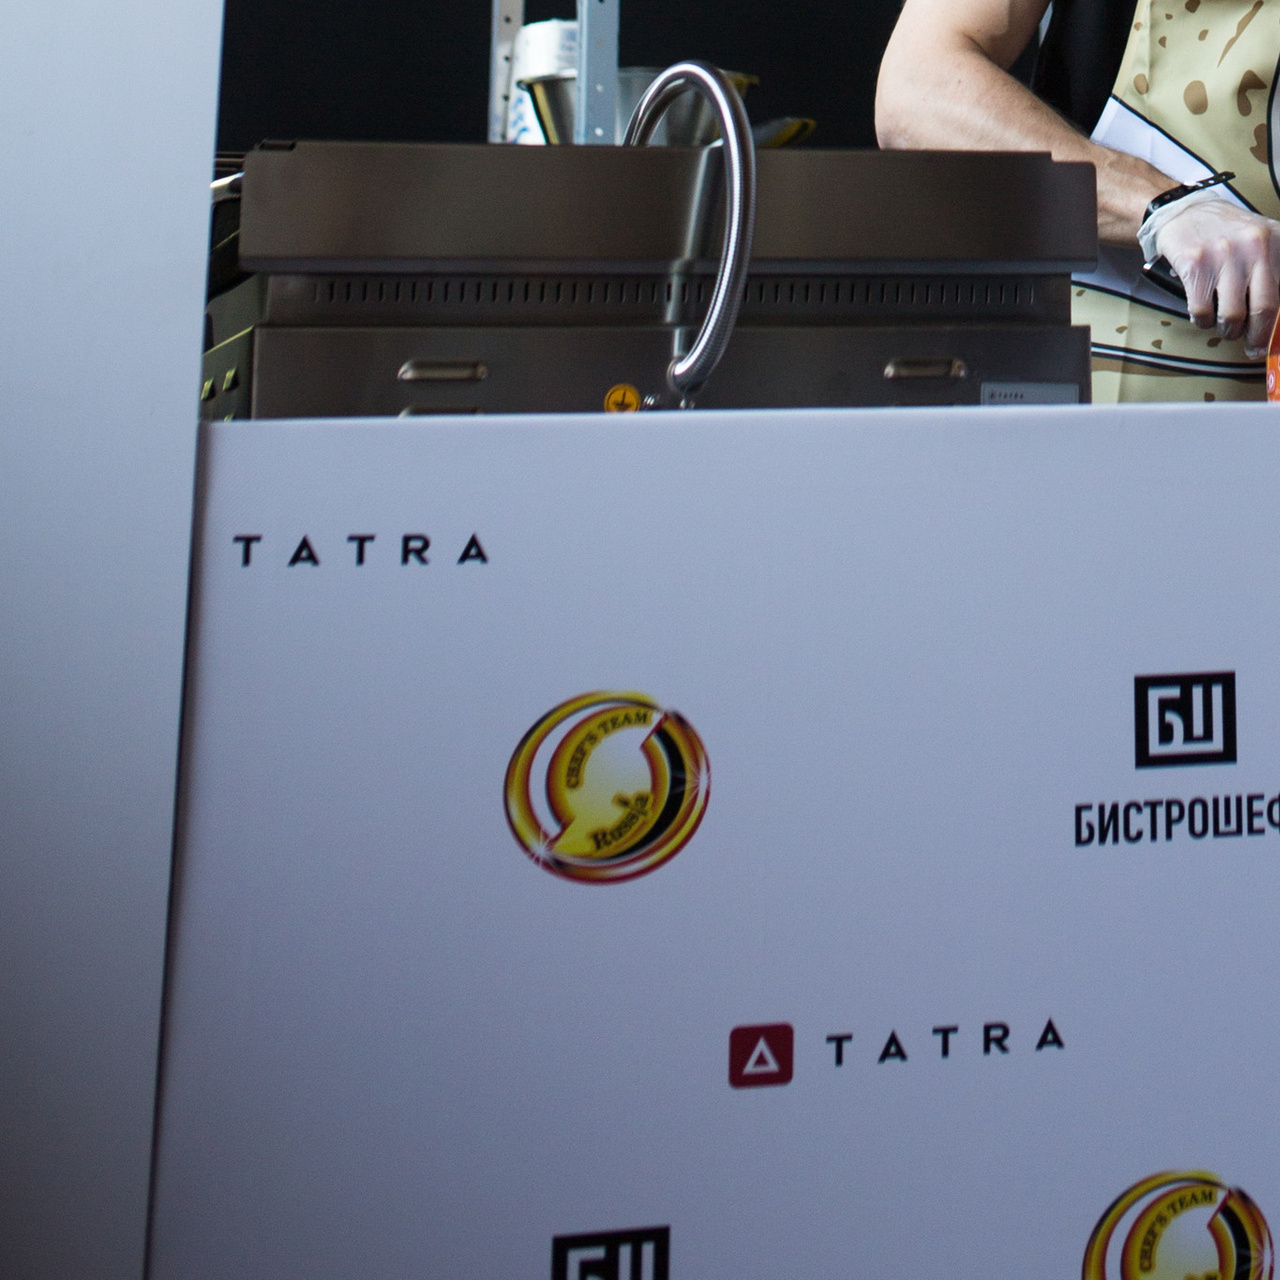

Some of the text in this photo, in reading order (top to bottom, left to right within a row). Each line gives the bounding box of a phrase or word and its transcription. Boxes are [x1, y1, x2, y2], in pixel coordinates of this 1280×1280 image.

[232, 533, 489, 568] TATRA
[597, 711, 648, 735] TEAM
[825, 1018, 1065, 1067] TATRA
[1166, 1189, 1215, 1215] TEAM
